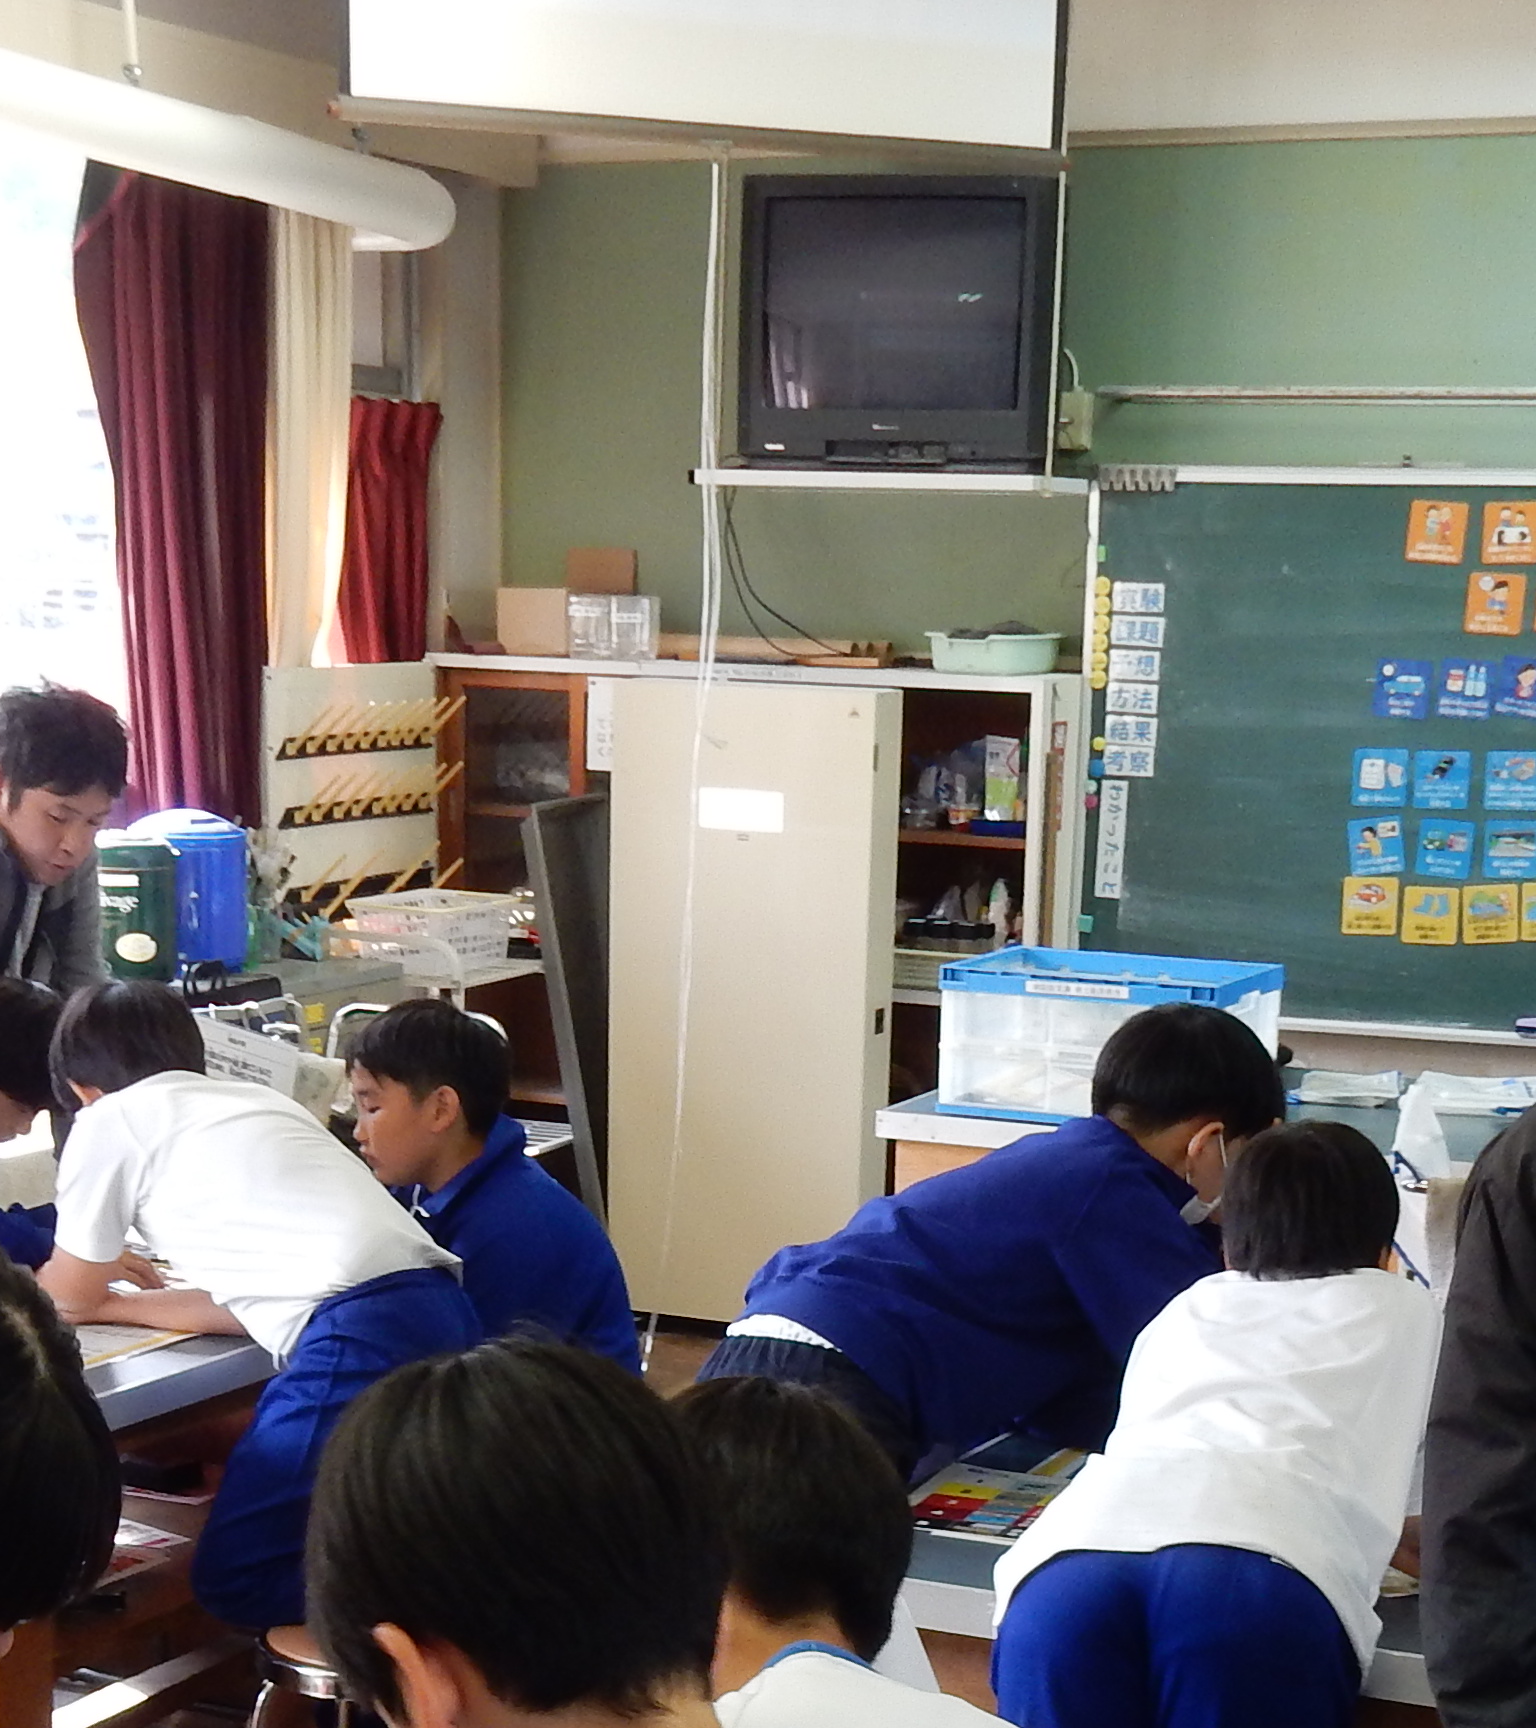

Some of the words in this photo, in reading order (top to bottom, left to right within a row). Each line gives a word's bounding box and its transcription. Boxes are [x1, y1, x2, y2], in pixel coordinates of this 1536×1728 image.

[1114, 618, 1161, 645] 課題
[1113, 653, 1156, 678] 予想
[1111, 687, 1154, 711] 方法
[1109, 719, 1153, 744] 結果
[1106, 750, 1151, 774] 考察
[1101, 783, 1124, 896] わかったこと
